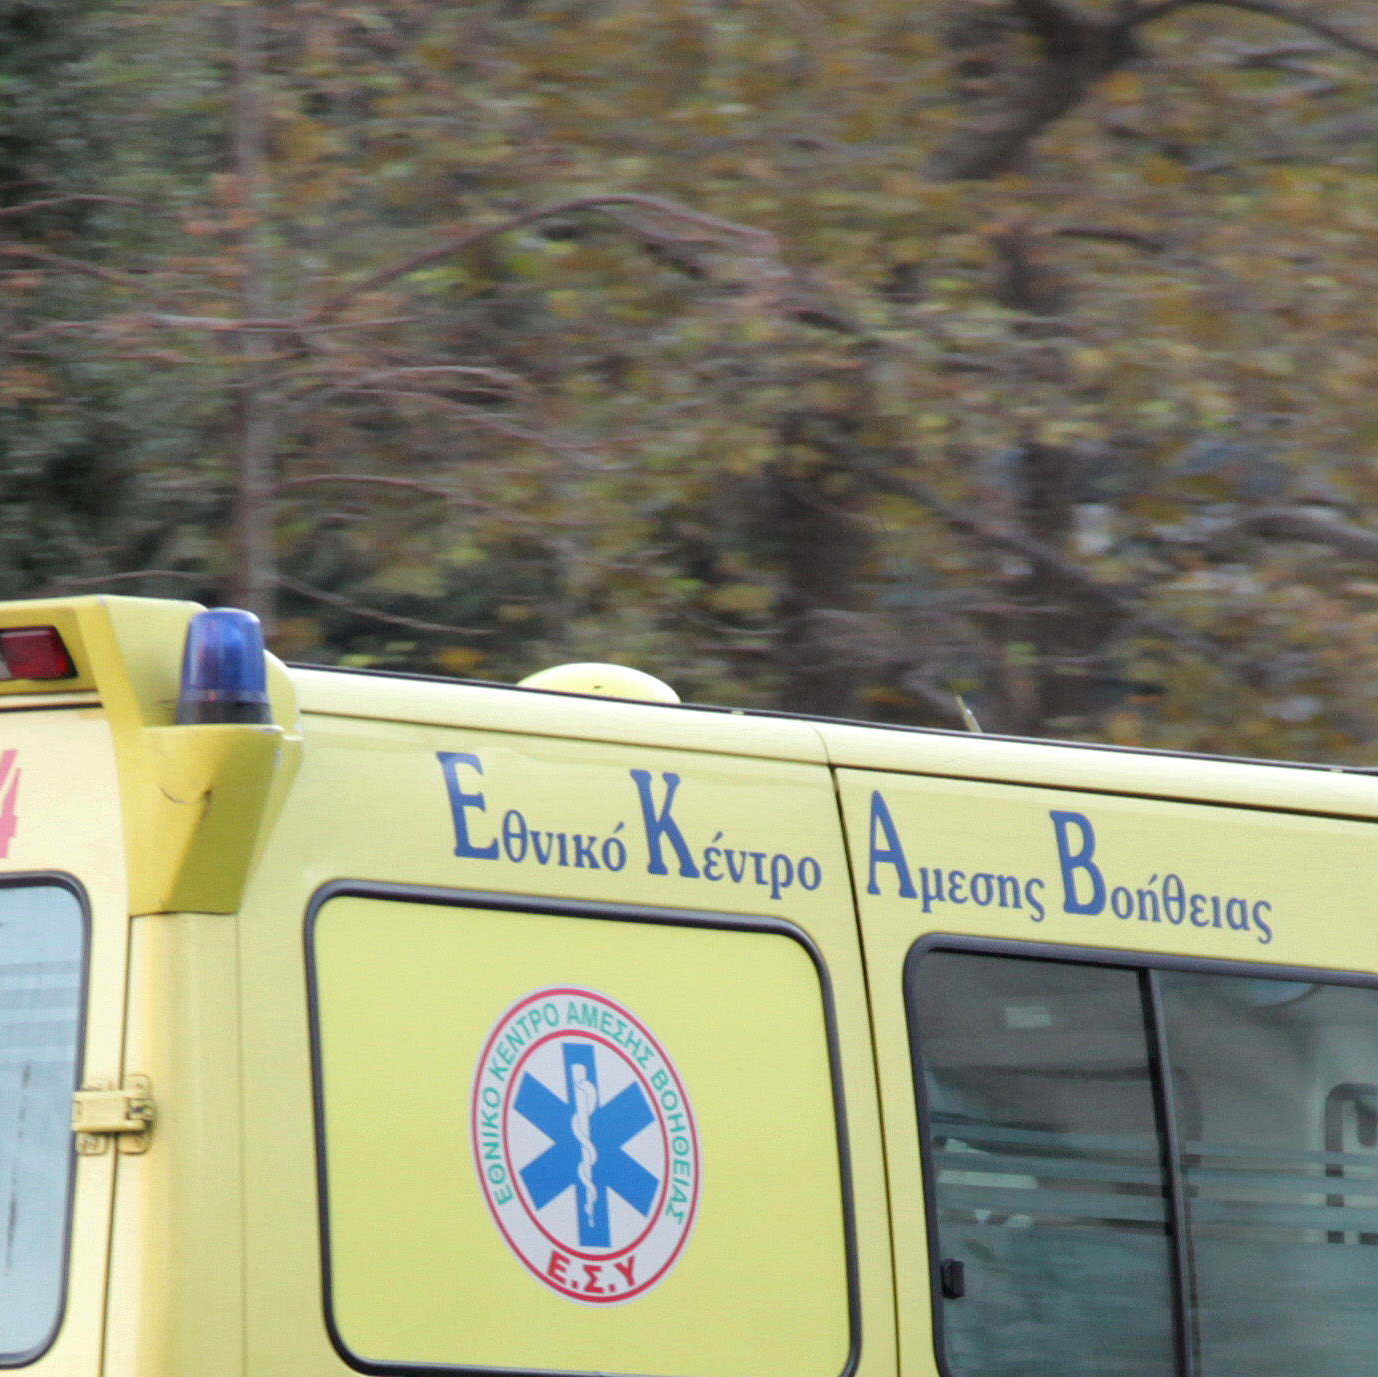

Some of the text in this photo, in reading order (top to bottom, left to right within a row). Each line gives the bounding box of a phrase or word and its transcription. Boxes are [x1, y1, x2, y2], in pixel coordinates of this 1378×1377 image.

[436, 750, 1273, 944] Εθνικό Κέντρο Αμεσης Βοήθειας
[480, 1001, 692, 1225] ΕΘΝΙΚΟ ΚΕΝΤΡΟ ΑΜΕΣΗΣ ΒΟΗΘΕΙΑΣ
